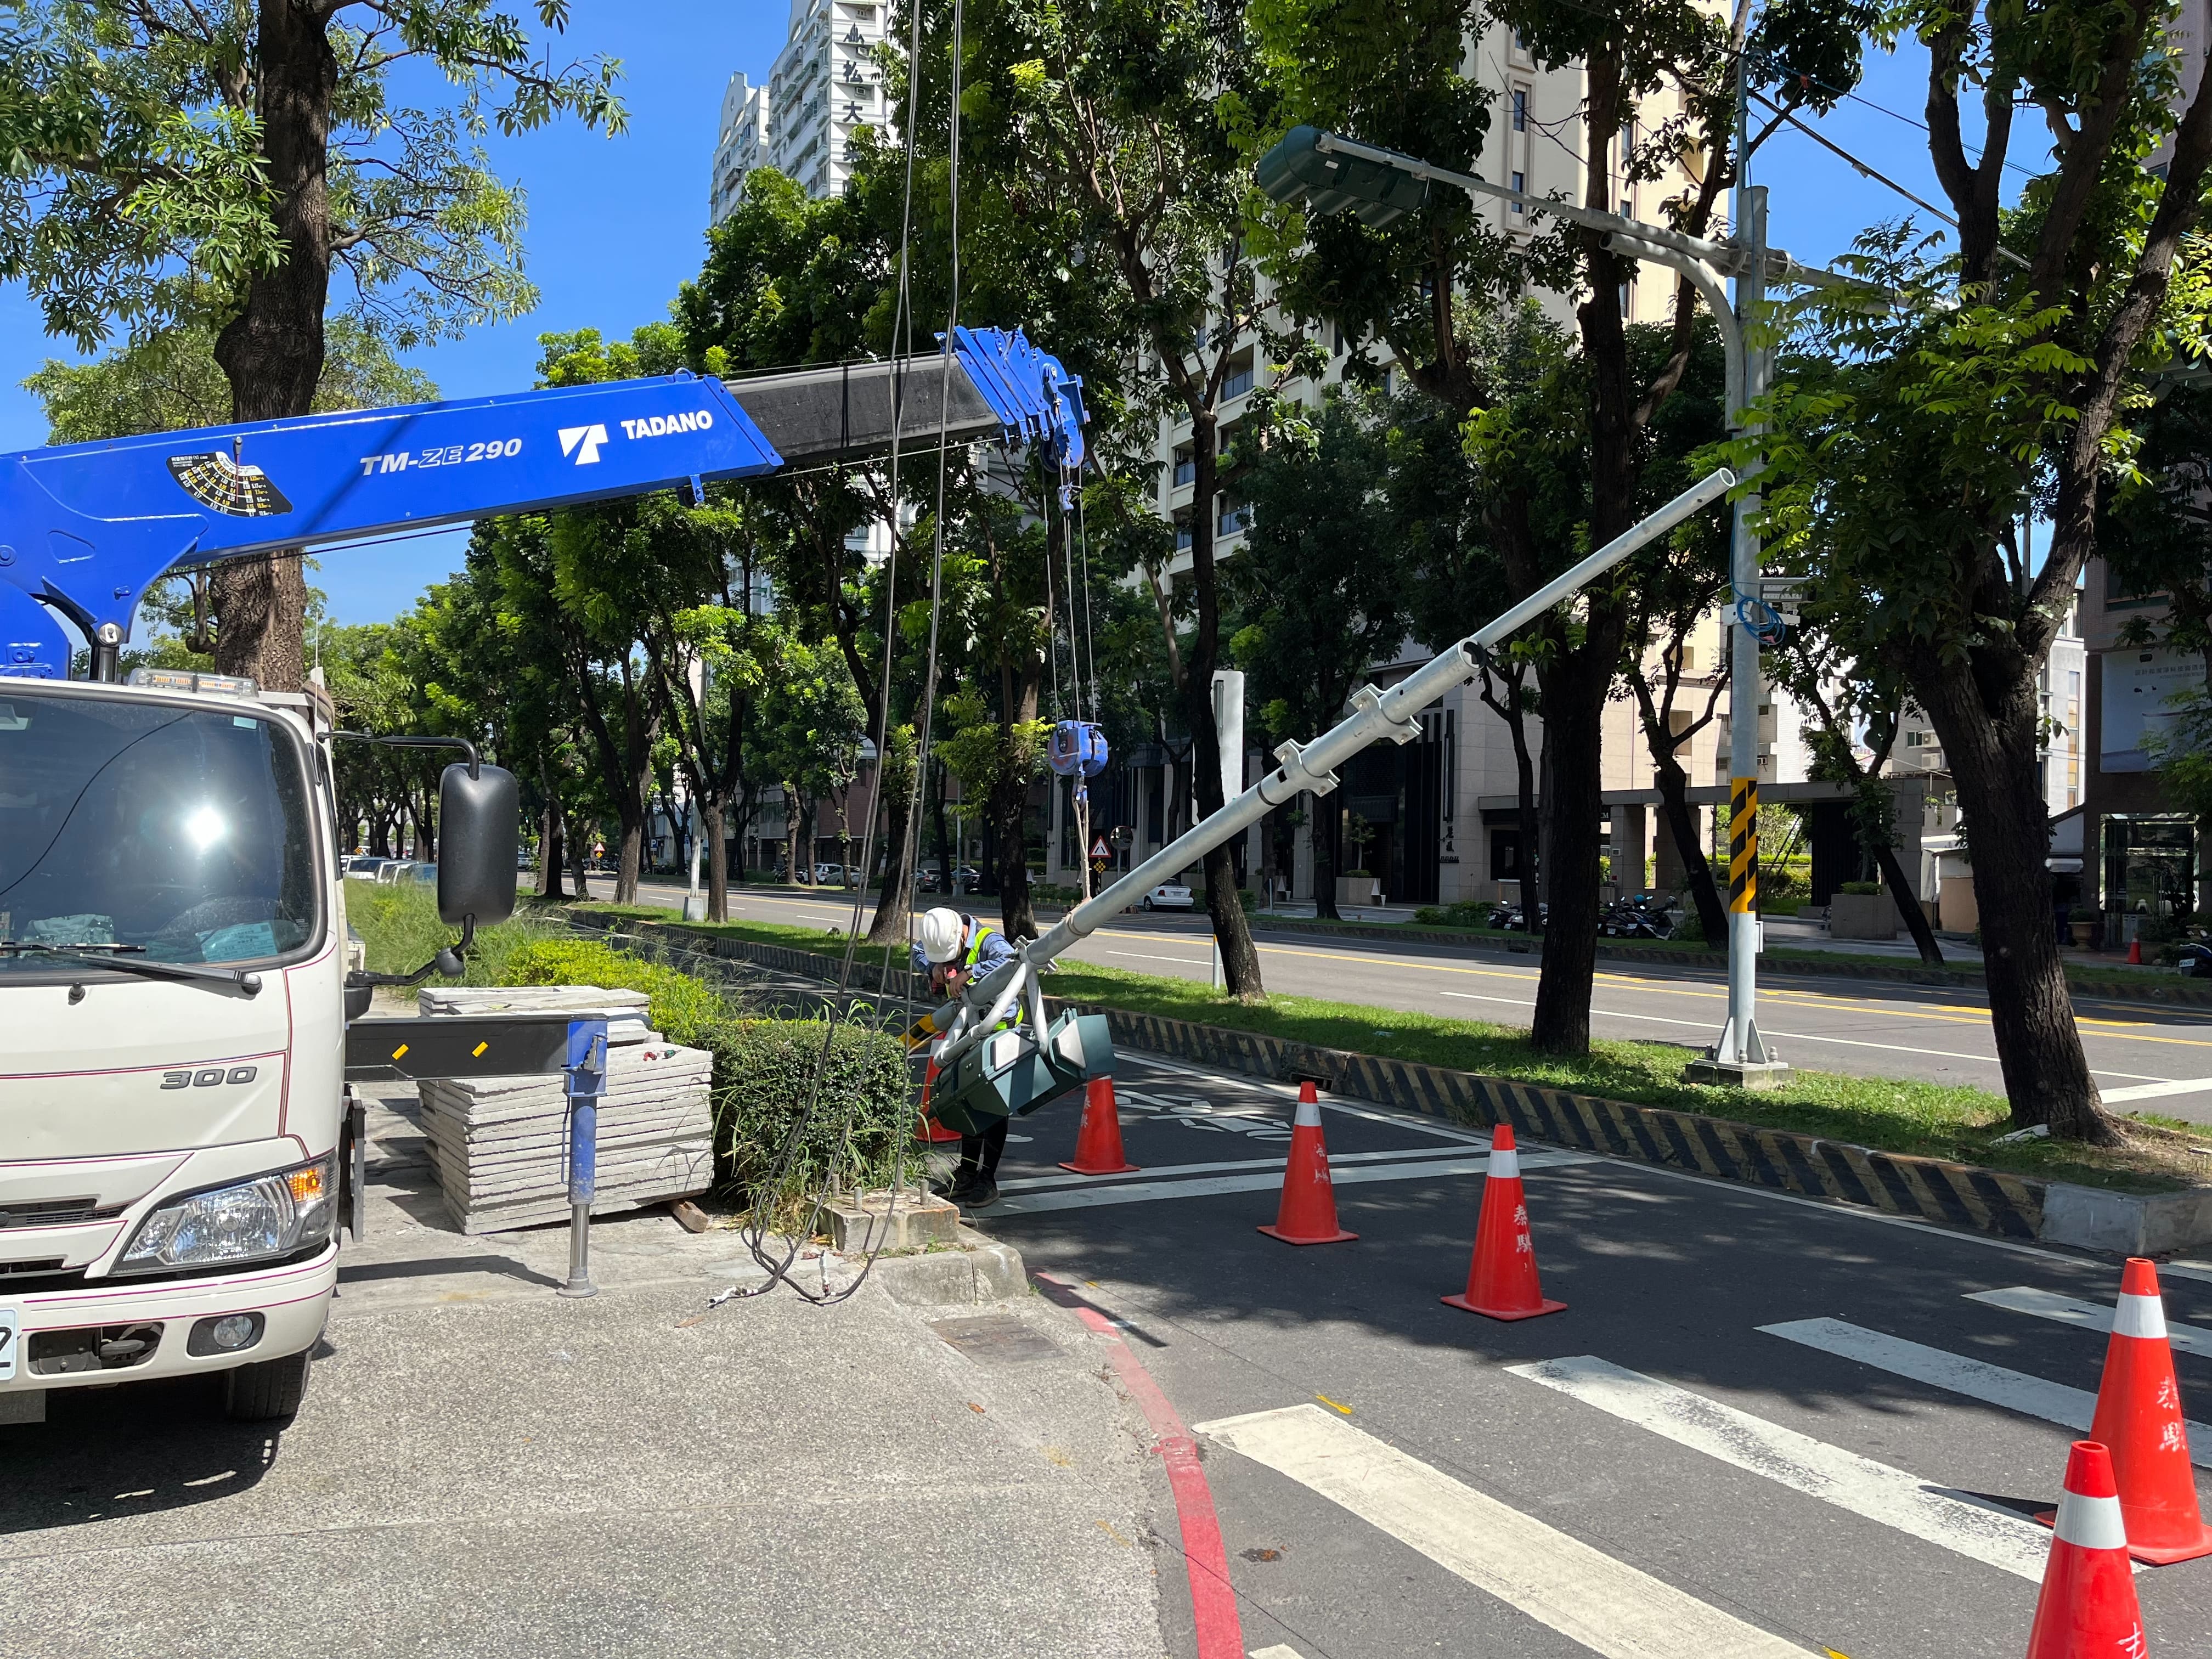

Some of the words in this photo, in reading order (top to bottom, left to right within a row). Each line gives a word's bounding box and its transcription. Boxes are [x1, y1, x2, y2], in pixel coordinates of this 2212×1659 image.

[620, 410, 712, 439] TADANO
[465, 438, 522, 462] 290
[160, 1066, 257, 1090] 300
